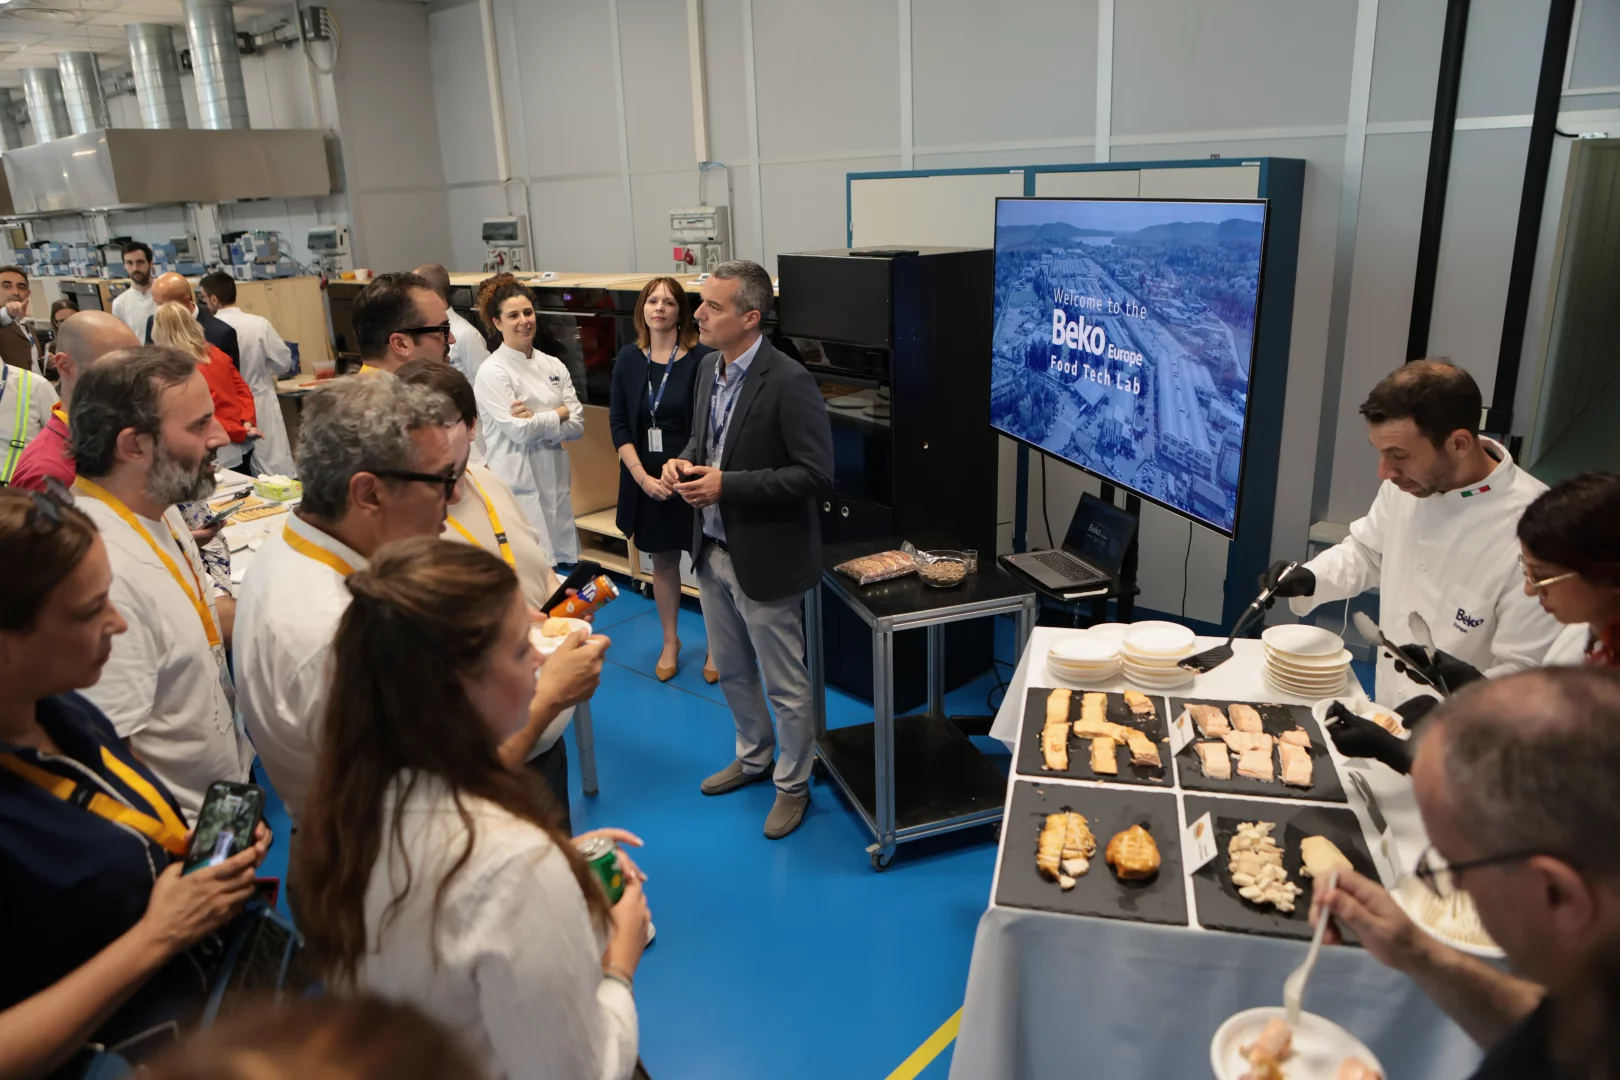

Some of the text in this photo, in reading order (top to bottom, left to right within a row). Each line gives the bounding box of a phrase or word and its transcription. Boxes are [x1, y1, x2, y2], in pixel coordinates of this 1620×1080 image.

[1054, 288, 1146, 319] Welcome to the
[1052, 308, 1142, 367] Beko Europe
[1051, 355, 1140, 395] Food Tech Lab
[1456, 608, 1484, 627] Beko
